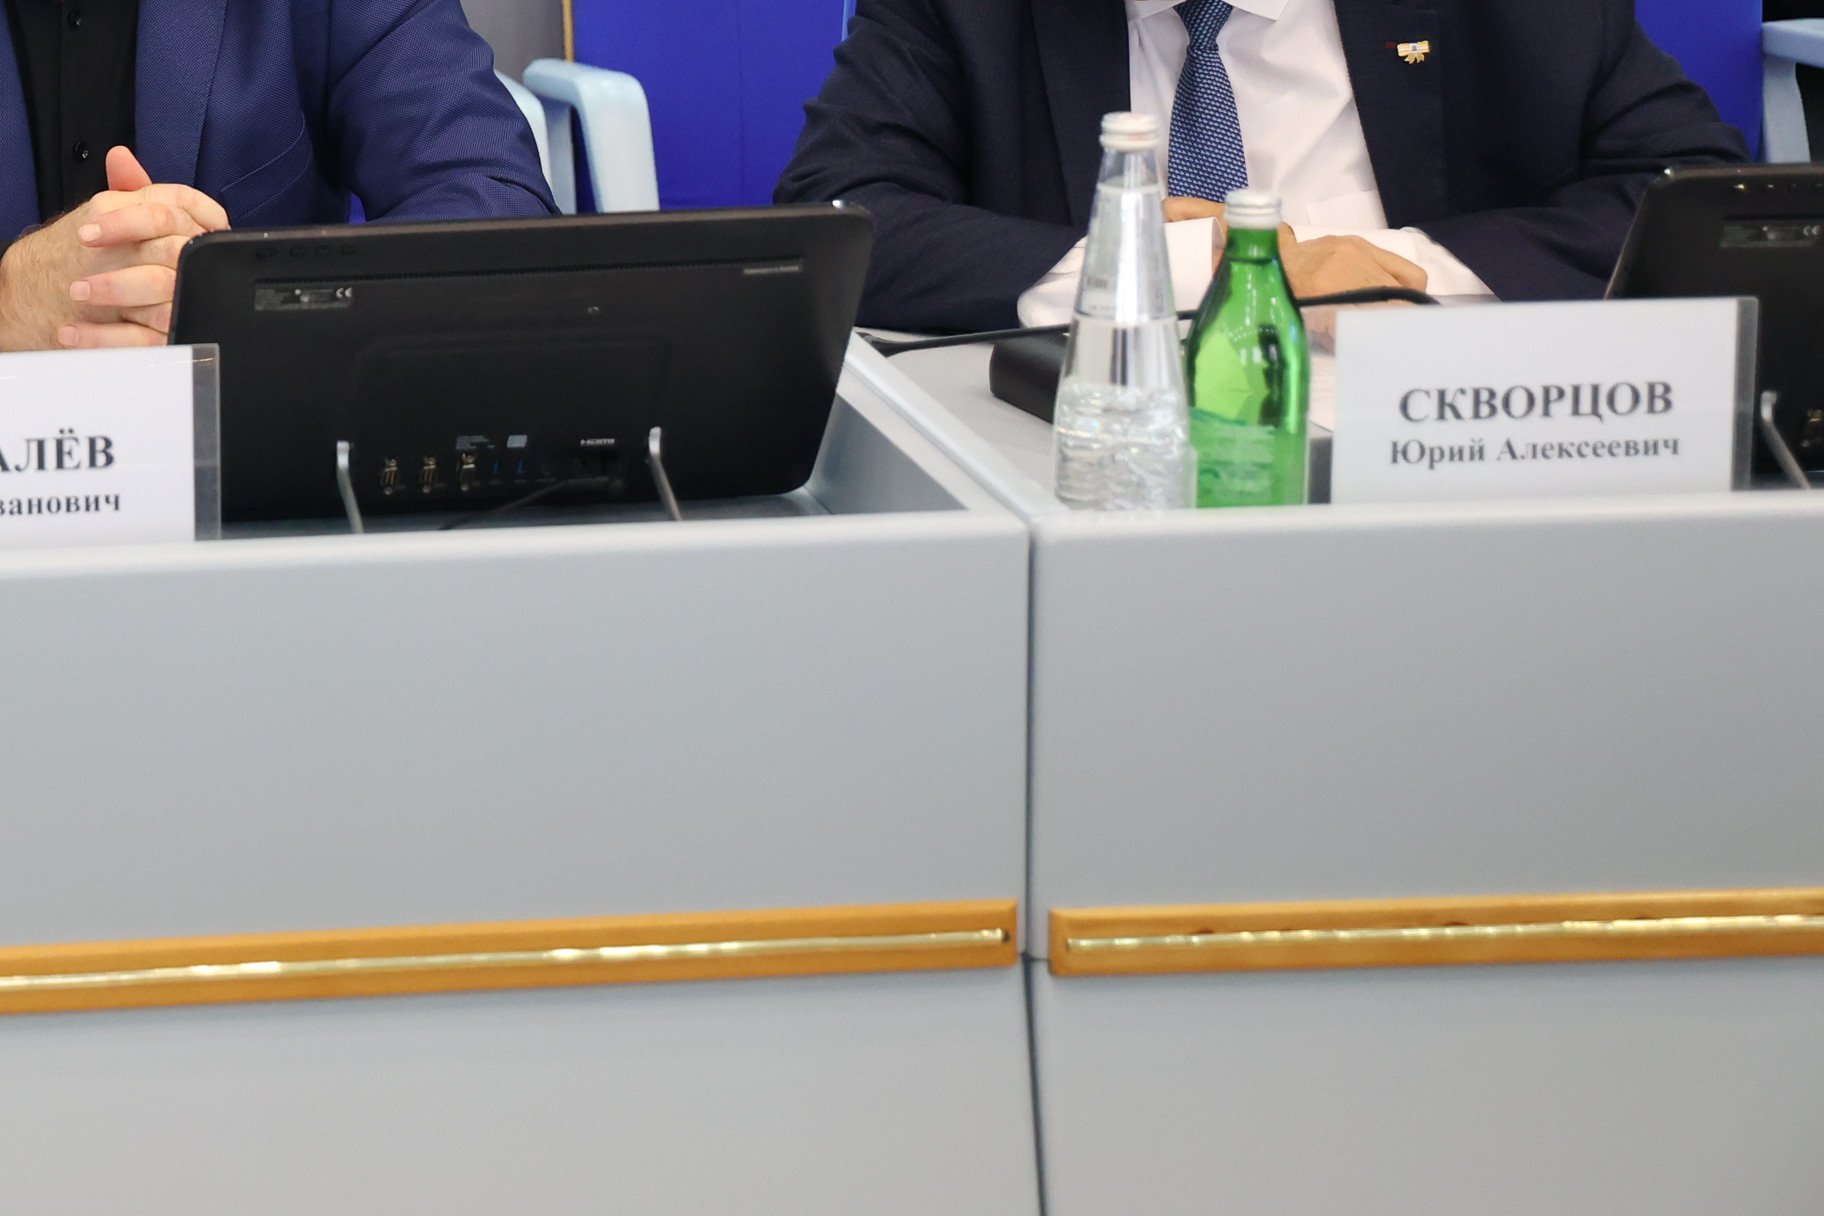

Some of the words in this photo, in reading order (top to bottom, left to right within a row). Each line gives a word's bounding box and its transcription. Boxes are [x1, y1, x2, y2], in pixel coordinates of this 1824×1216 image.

[1398, 381, 1674, 424] СКВОРЦОВ
[1390, 437, 1485, 471] Юрий
[1495, 435, 1680, 464] Алексеевич
